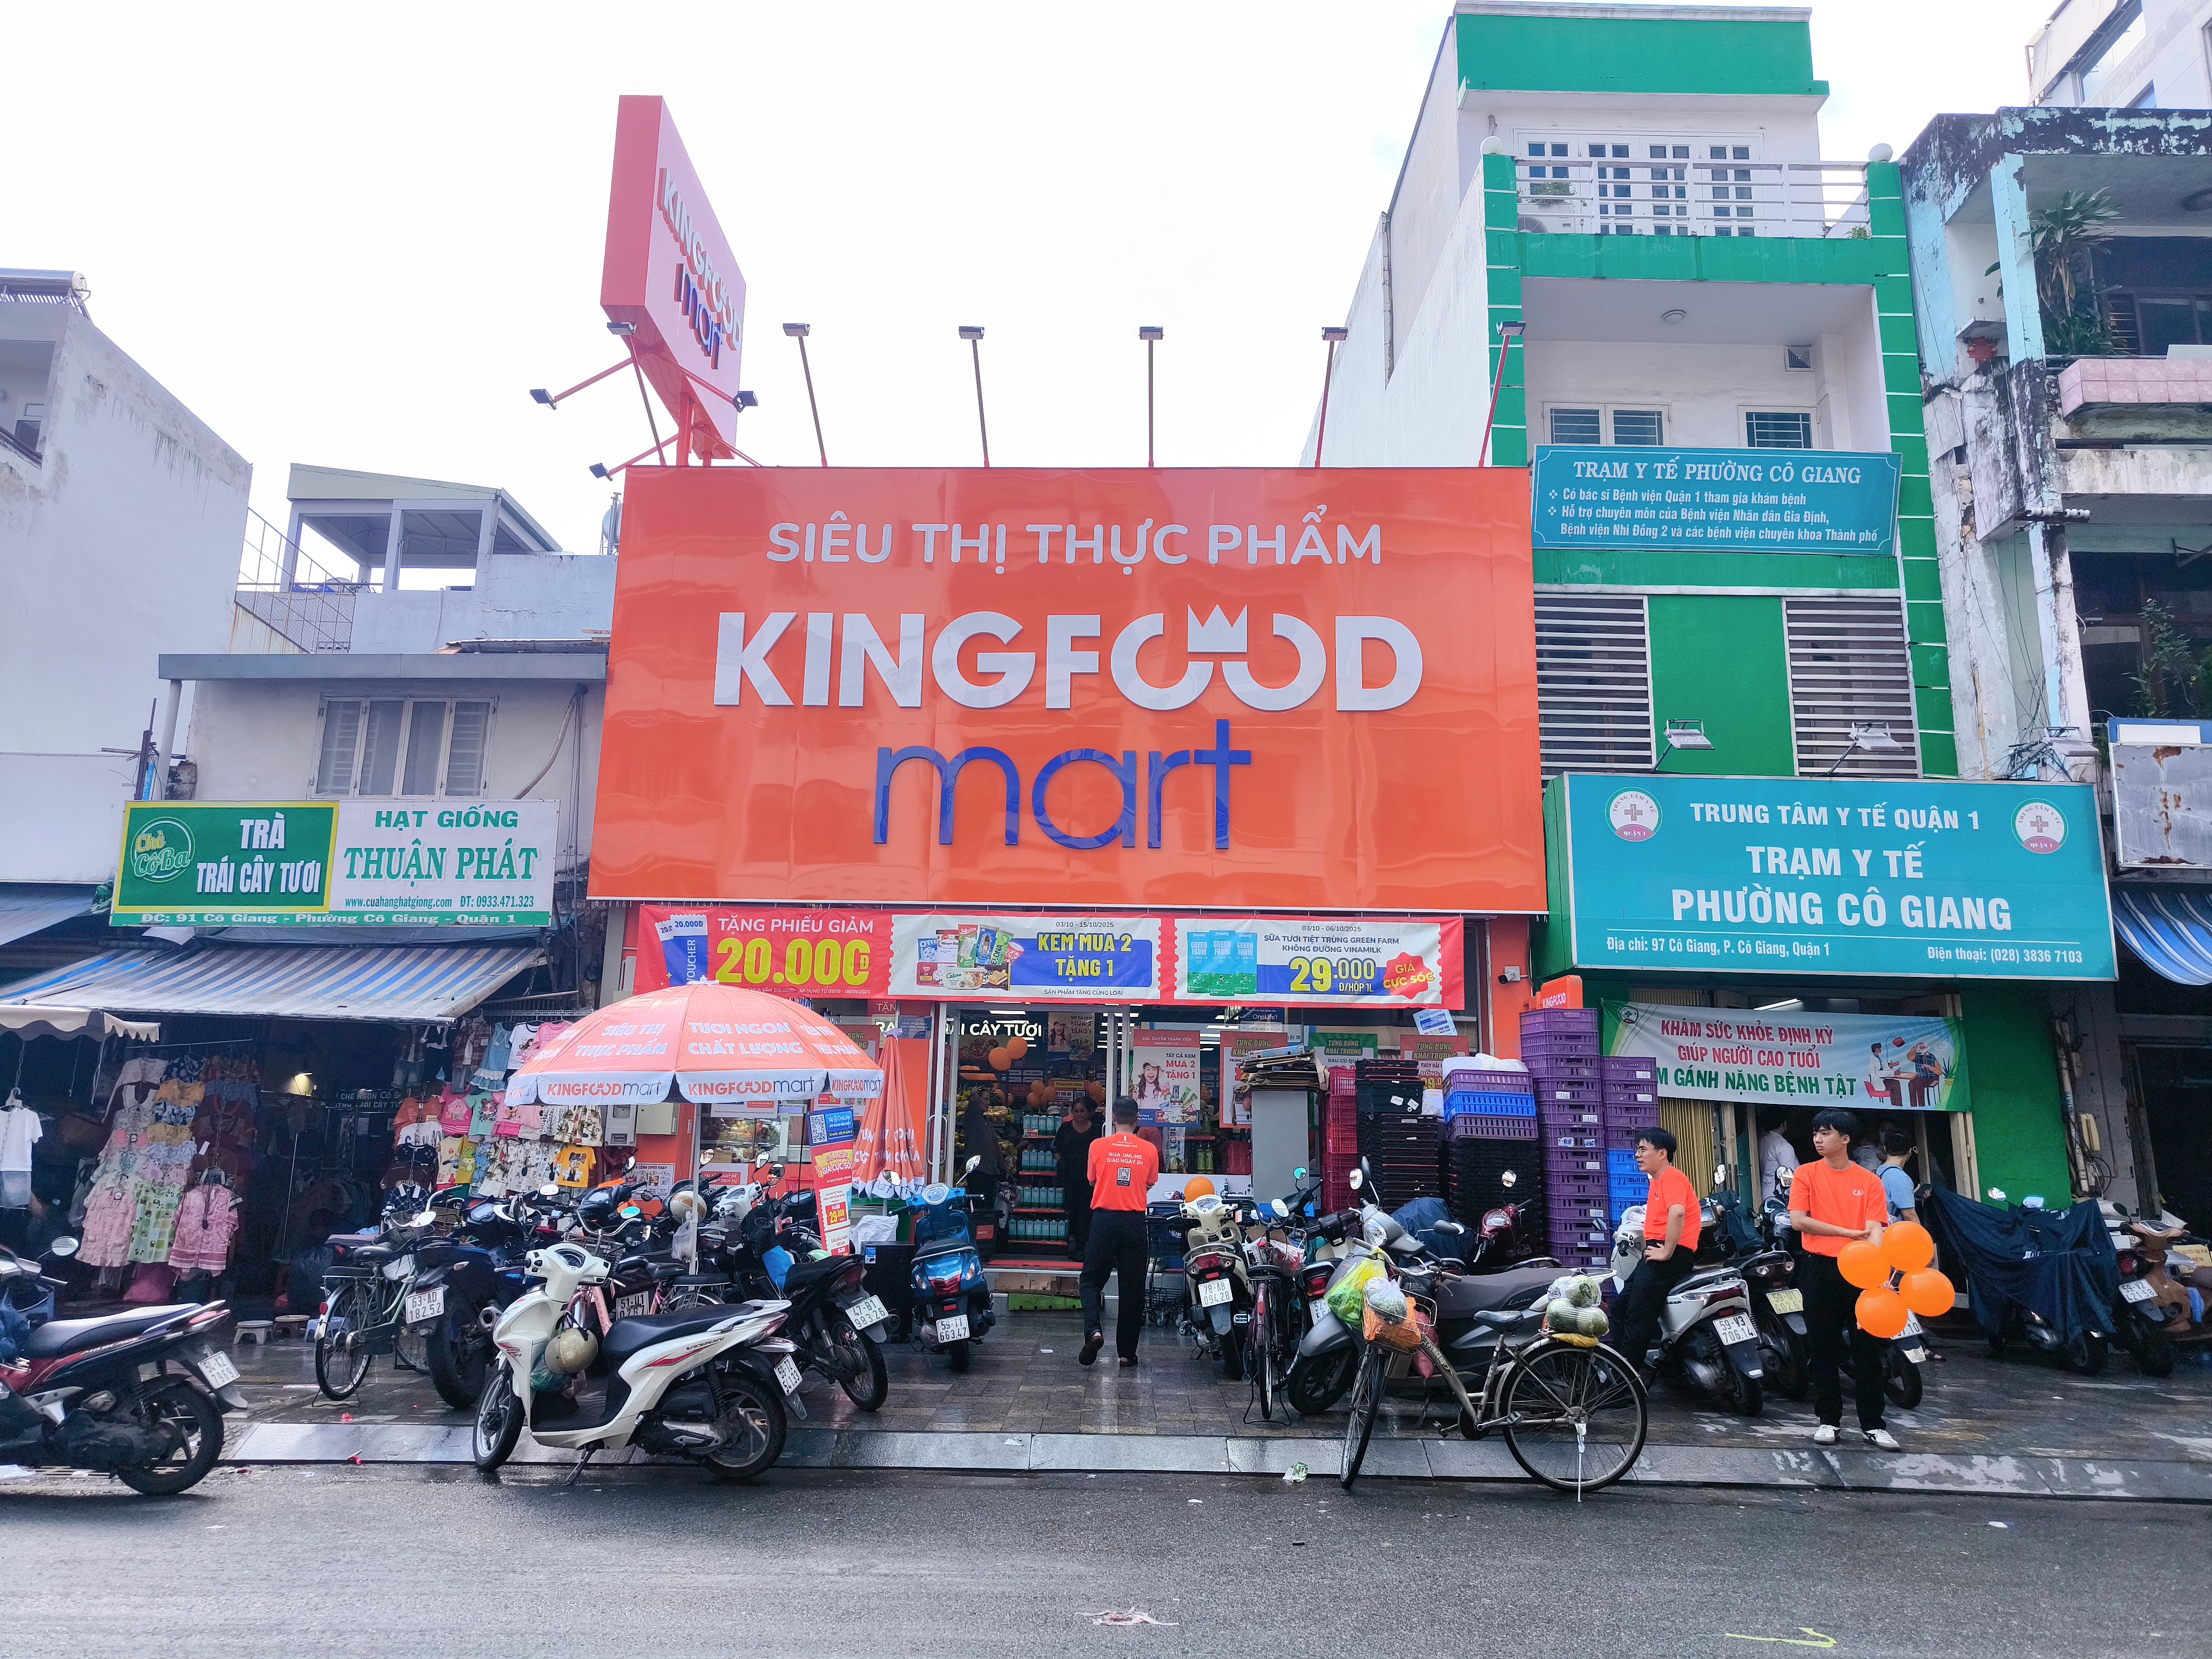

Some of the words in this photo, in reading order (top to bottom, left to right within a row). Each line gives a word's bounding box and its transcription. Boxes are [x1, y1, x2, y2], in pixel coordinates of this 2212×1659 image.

[1573, 461, 1629, 482] TRẠM
[1635, 463, 1648, 479] Y
[1653, 455, 1680, 480] TẾ
[1684, 460, 1763, 482] PHƯỜNG
[1769, 461, 1795, 482] CÔ
[1802, 467, 1862, 484] GIANG
[1563, 488, 1576, 500] Có
[1580, 488, 1597, 501] bác
[1601, 489, 1611, 501] sĩ
[1613, 489, 1638, 503] Bệnh
[1641, 489, 1662, 504] viện
[1665, 490, 1691, 504] Quận
[1695, 491, 1700, 502] 1
[1704, 491, 1729, 503] tham
[1732, 492, 1748, 506] gia
[1751, 493, 1778, 504] khám
[1782, 493, 1806, 507] bệnh
[1562, 504, 1575, 517] Hỗ
[1579, 506, 1593, 520] trợ
[1596, 507, 1631, 521] chuyên
[1635, 507, 1655, 519] môn
[1659, 507, 1677, 520] của
[1681, 508, 1706, 522] Bệnh
[1709, 509, 1729, 523] viện
[1733, 509, 1759, 522] Nhân
[1762, 510, 1781, 522] dân
[1784, 510, 1800, 522] Gia
[1804, 511, 1829, 525] Định,
[767, 510, 892, 564] SIÊU
[913, 523, 1007, 575] THỊ
[1026, 517, 1189, 576] THỰC
[1208, 503, 1381, 565] PHẨM
[1561, 523, 1586, 537] Bệnh
[1589, 524, 1610, 538] viện
[1613, 524, 1629, 536] Nhi
[1633, 523, 1658, 539] Đồng
[1661, 525, 1667, 537] 2
[1671, 525, 1682, 537] và
[1685, 526, 1704, 538] các
[1707, 527, 1732, 540] bệnh
[1735, 527, 1755, 541] viện
[1758, 528, 1795, 542] chuyên
[1798, 528, 1822, 541] khoa
[1825, 528, 1856, 541] Thành
[1859, 528, 1879, 544] phố
[713, 603, 1424, 711] KINGFOOD
[873, 719, 1252, 851] mart
[375, 811, 428, 831] HẠT
[437, 804, 518, 828] GIỐNG
[1690, 803, 1769, 824] TRUNG
[1777, 802, 1828, 825] TÂM
[1836, 807, 1850, 826] Y
[1858, 802, 1887, 827] TẾ
[1894, 805, 1959, 833] QUẬN
[1968, 811, 1979, 830] 1
[240, 811, 285, 849] TRÀ
[136, 830, 166, 853] Chè
[343, 838, 447, 887] THUẬN
[455, 838, 538, 879] PHÁT
[1746, 846, 1842, 880] TRẠM
[1852, 849, 1872, 876] Y
[1883, 840, 1926, 878] TẾ
[197, 854, 235, 893] TRÁI
[239, 854, 274, 893] CÂY
[280, 859, 321, 893] TƯƠI
[345, 895, 452, 909] www.cuahanghatgiong.com
[460, 896, 474, 907] ĐT:
[476, 895, 534, 907] 0933.471.323
[1672, 883, 1823, 925] PHƯỜNG
[1838, 887, 1886, 927] CÔ
[1900, 895, 2012, 930] GIANG
[141, 913, 170, 922] ĐC:
[176, 913, 197, 922] 91
[204, 913, 225, 922] Cô
[231, 913, 277, 923] Giang
[295, 912, 358, 924] Phường
[364, 913, 385, 923] Cô
[392, 914, 439, 924] Giang
[507, 914, 516, 922] 1
[718, 915, 765, 935] TẶNG
[771, 915, 822, 933] PHIẾU
[828, 916, 873, 934] GIẢM
[1038, 934, 1074, 951] KEM
[1080, 934, 1115, 952] MUA
[1121, 935, 1131, 952] 2
[1264, 933, 1280, 942] SỮA
[1282, 934, 1301, 942] TƯƠI
[1303, 935, 1319, 945] TIỆT
[1321, 935, 1348, 943] TRÙNG
[1282, 944, 1311, 952] KHÔNG
[1312, 945, 1342, 953] ĐƯỜNG
[1607, 937, 1625, 953] Địa
[1628, 936, 1648, 952] chỉ:
[1652, 939, 1664, 952] 97
[1669, 939, 1683, 952] Cô
[1687, 939, 1720, 956] Giang,
[1723, 940, 1734, 953] P.
[1738, 940, 1752, 954] Cô
[1755, 941, 1789, 957] Giang,
[1792, 942, 1817, 959] Quận
[1824, 942, 1830, 956] 1
[686, 939, 697, 983] VOUCHER
[1927, 946, 1952, 962] Điện
[1955, 947, 1987, 964] thoại:
[1991, 948, 2019, 965] (028)
[2024, 949, 2051, 963] 3836
[2054, 950, 2082, 963] 7103
[1055, 955, 1101, 982] TẶNG
[1107, 960, 1113, 976] 1
[1290, 957, 1375, 992] 29.000
[1395, 960, 1416, 974] GIÁ
[1339, 981, 1364, 994] Đ/HỘP
[1366, 984, 1374, 993] 1L
[1383, 977, 1408, 989] CỰC
[1411, 971, 1435, 984] SỐC
[601, 1022, 638, 1036] SIÊU
[640, 1023, 666, 1036] THỊ
[688, 1022, 732, 1034] TƯƠI
[736, 1022, 790, 1034] NGON
[970, 1020, 1001, 1036] CÂY
[1004, 1022, 1042, 1037] TƯƠI
[1661, 1018, 1702, 1037] KHÁM
[1705, 1019, 1733, 1040] SỨC
[1737, 1020, 1775, 1042] KHỎE
[1778, 1026, 1811, 1046] ĐỊNH
[1815, 1024, 1833, 1044] KỲ
[575, 1045, 616, 1058] THỰC
[616, 1038, 668, 1055] PHẨM
[688, 1038, 735, 1055] CHẤT
[741, 1042, 804, 1057] LƯỢNG
[1677, 1042, 1708, 1062] GIÚP
[1712, 1046, 1754, 1065] NGƯỜI
[1757, 1050, 1783, 1067] CAO
[1788, 1044, 1820, 1069] TUỔI
[1166, 1070, 1189, 1080] TẶNG
[1674, 1064, 1719, 1090] GÁNH
[1725, 1069, 1769, 1095] NẶNG
[1775, 1071, 1819, 1097] BỆNH
[1824, 1073, 1857, 1099] TẬT
[1203, 1282, 1226, 1294] 78-AB
[1772, 1291, 1797, 1303] 59-U1
[2122, 1282, 2146, 1293] 59-V2
[2126, 1289, 2155, 1301] 421.58
[412, 1292, 437, 1307] 63-AD
[1204, 1291, 1230, 1305] 094.28
[409, 1302, 441, 1320] 182.52
[853, 1299, 876, 1317] 47-B1
[854, 1307, 886, 1327] 983.26
[941, 1318, 962, 1330] 59-T1
[1719, 1316, 1745, 1331] 59-V3
[940, 1327, 967, 1341] 663.47
[1722, 1327, 1754, 1343] 706.14
[211, 1367, 234, 1385] 7969
[783, 1370, 800, 1393] 541.33
